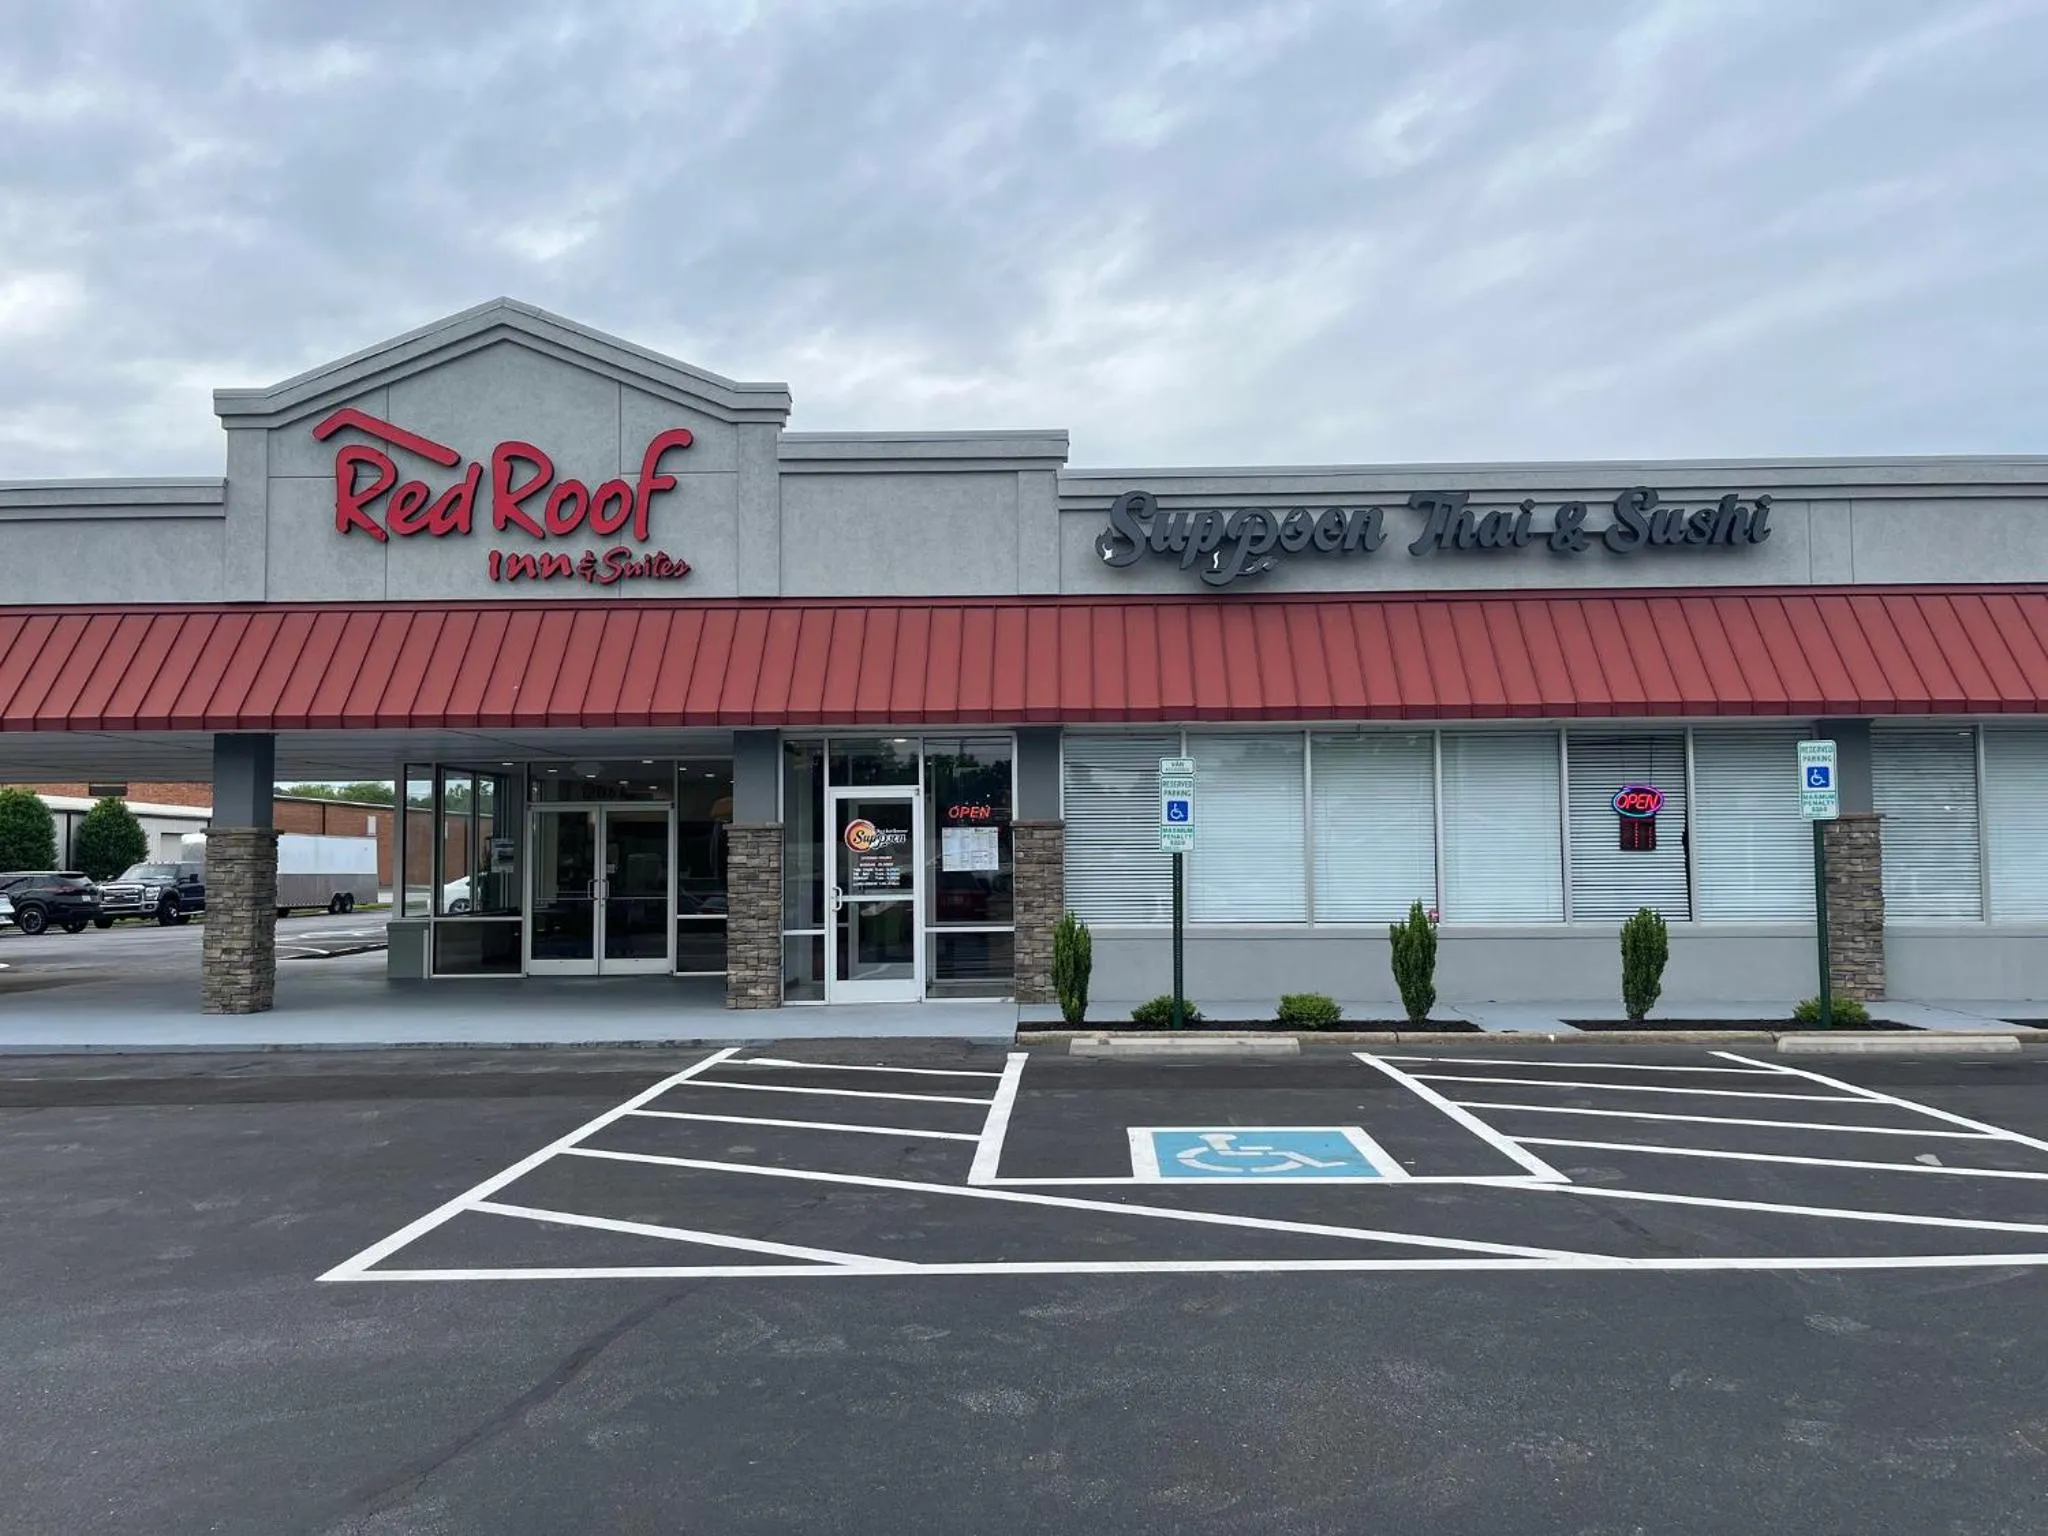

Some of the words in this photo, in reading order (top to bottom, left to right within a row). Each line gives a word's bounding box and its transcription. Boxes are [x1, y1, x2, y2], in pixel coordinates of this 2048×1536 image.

[335, 444, 484, 542] Red
[492, 428, 694, 542] Roof
[1408, 490, 1536, 556] Thai
[1548, 500, 1590, 552] &
[1602, 486, 1774, 554] Sushi
[488, 549, 574, 581] Inn
[599, 547, 692, 585] Suites
[1162, 780, 1193, 788] RESERVED
[948, 804, 991, 819] OPEN
[1616, 794, 1659, 809] OPEN
